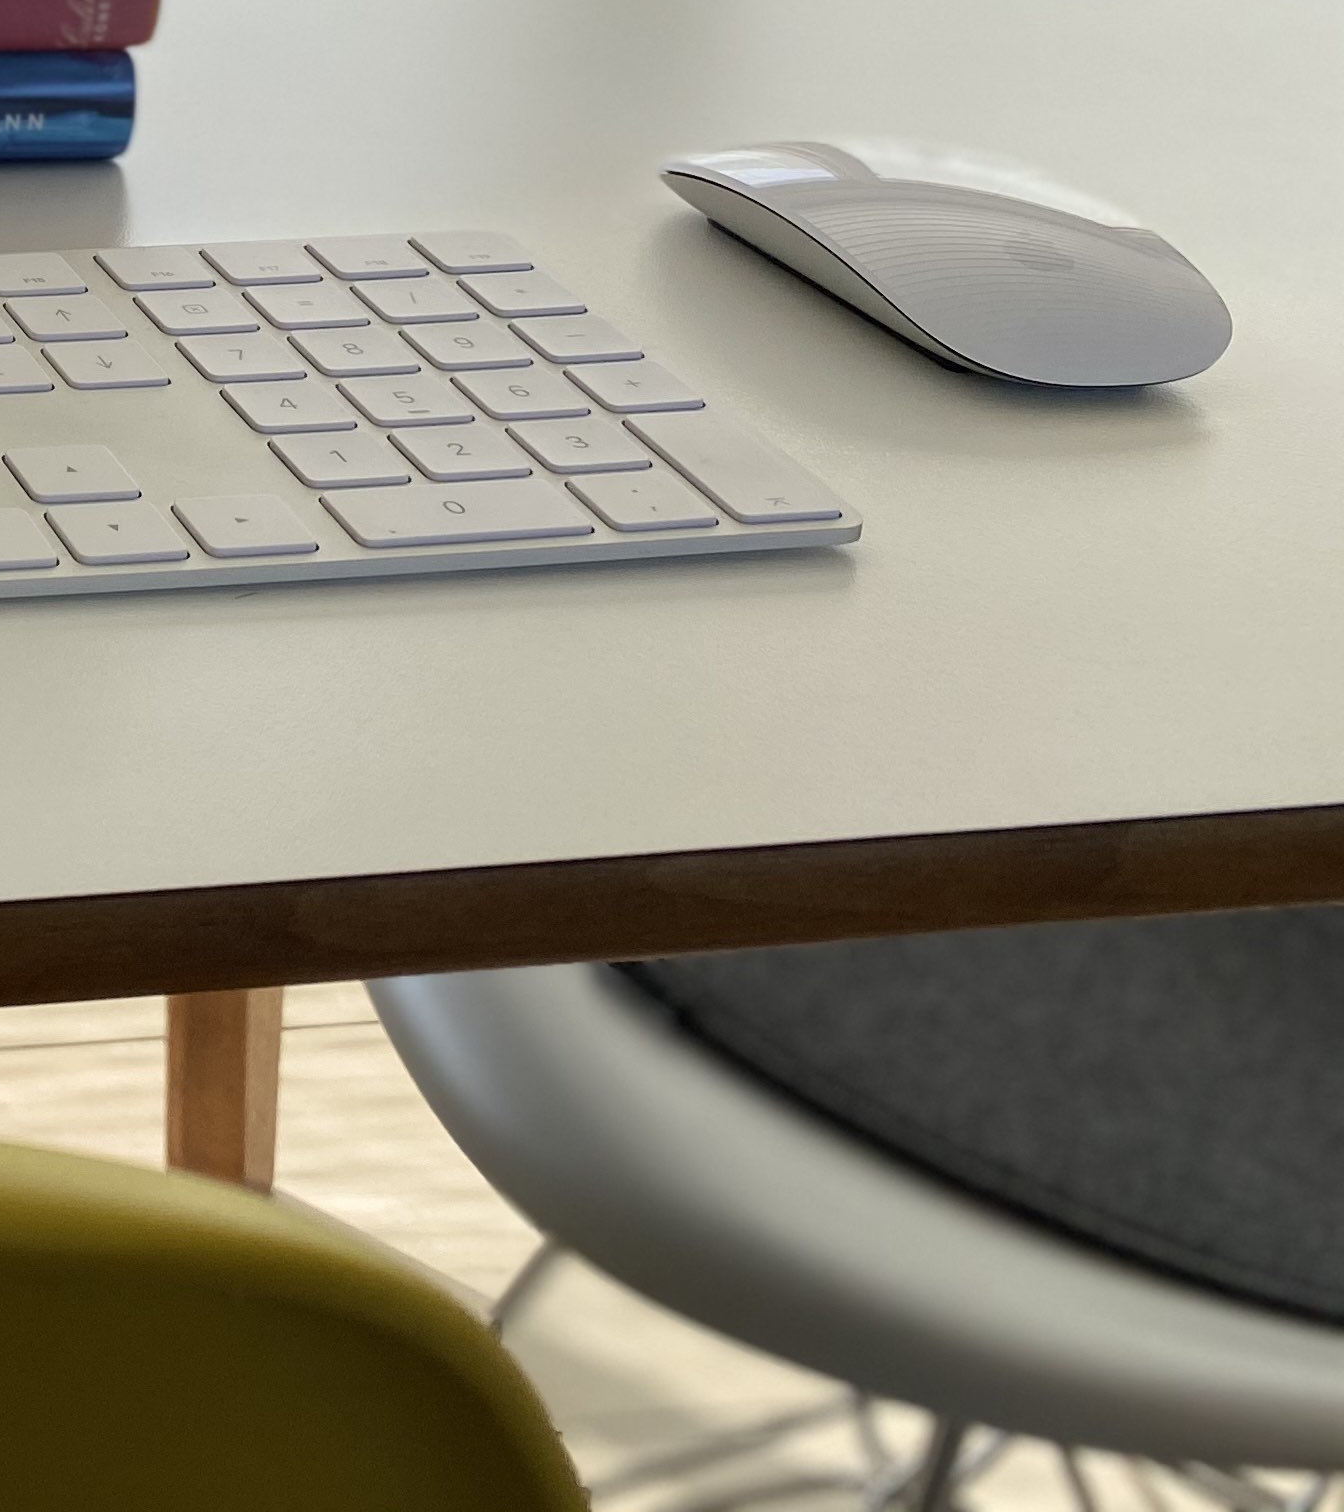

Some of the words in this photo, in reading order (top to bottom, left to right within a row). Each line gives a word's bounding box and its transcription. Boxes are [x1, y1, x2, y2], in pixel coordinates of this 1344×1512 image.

[341, 342, 365, 356] 8
[453, 337, 475, 349] 9
[228, 348, 244, 361] 7
[392, 391, 416, 404] 5
[508, 385, 530, 398] 6
[279, 397, 298, 410] 4
[565, 435, 590, 449] 3
[446, 442, 472, 456] 2
